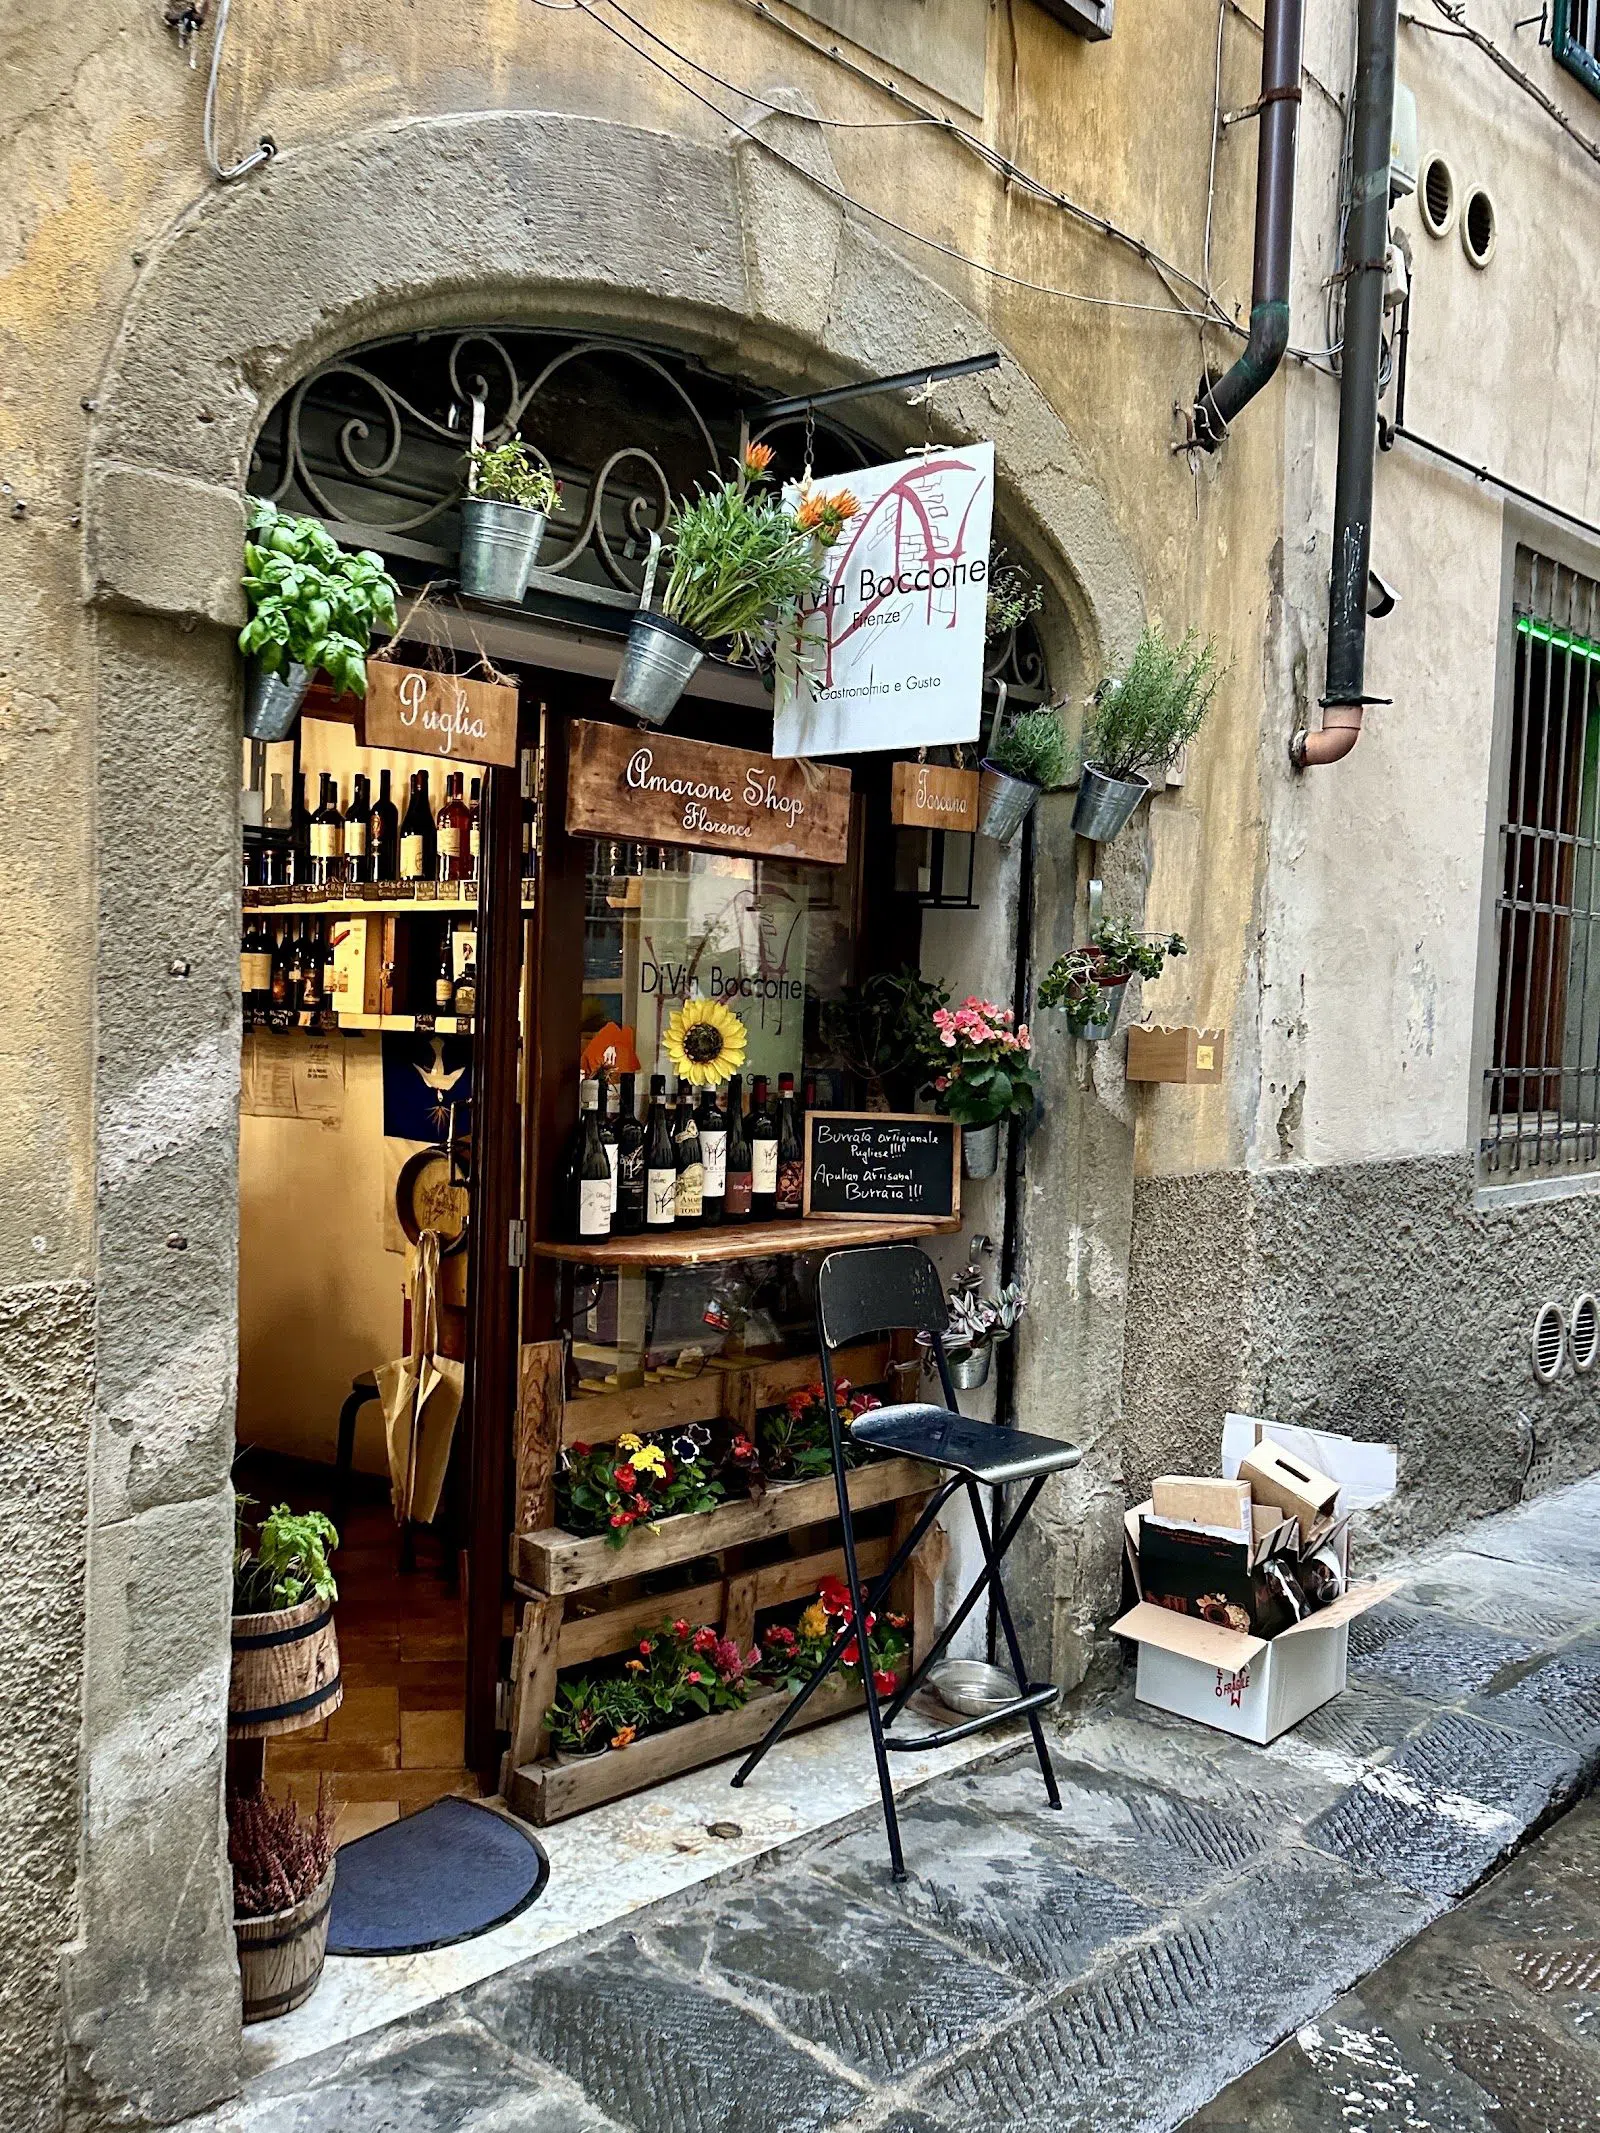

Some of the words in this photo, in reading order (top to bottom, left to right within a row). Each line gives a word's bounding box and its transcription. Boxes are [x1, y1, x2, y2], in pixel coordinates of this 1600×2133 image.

[860, 559, 986, 602] Boccone
[852, 611, 900, 629] Firenze
[819, 683, 890, 700] Gastronomia
[894, 682, 901, 692] e
[906, 675, 941, 690] Gusto
[399, 673, 488, 754] Puglia
[626, 748, 733, 803] Amarone
[743, 767, 804, 829] Shop
[916, 768, 967, 814] Toscana
[682, 801, 752, 838] Florence
[641, 962, 699, 997] DiVin
[711, 966, 802, 999] Boccone
[817, 1125, 874, 1144] Burrata
[878, 1129, 939, 1152] artigianale
[814, 1164, 858, 1186] Apulian
[845, 1183, 904, 1200] Burrata
